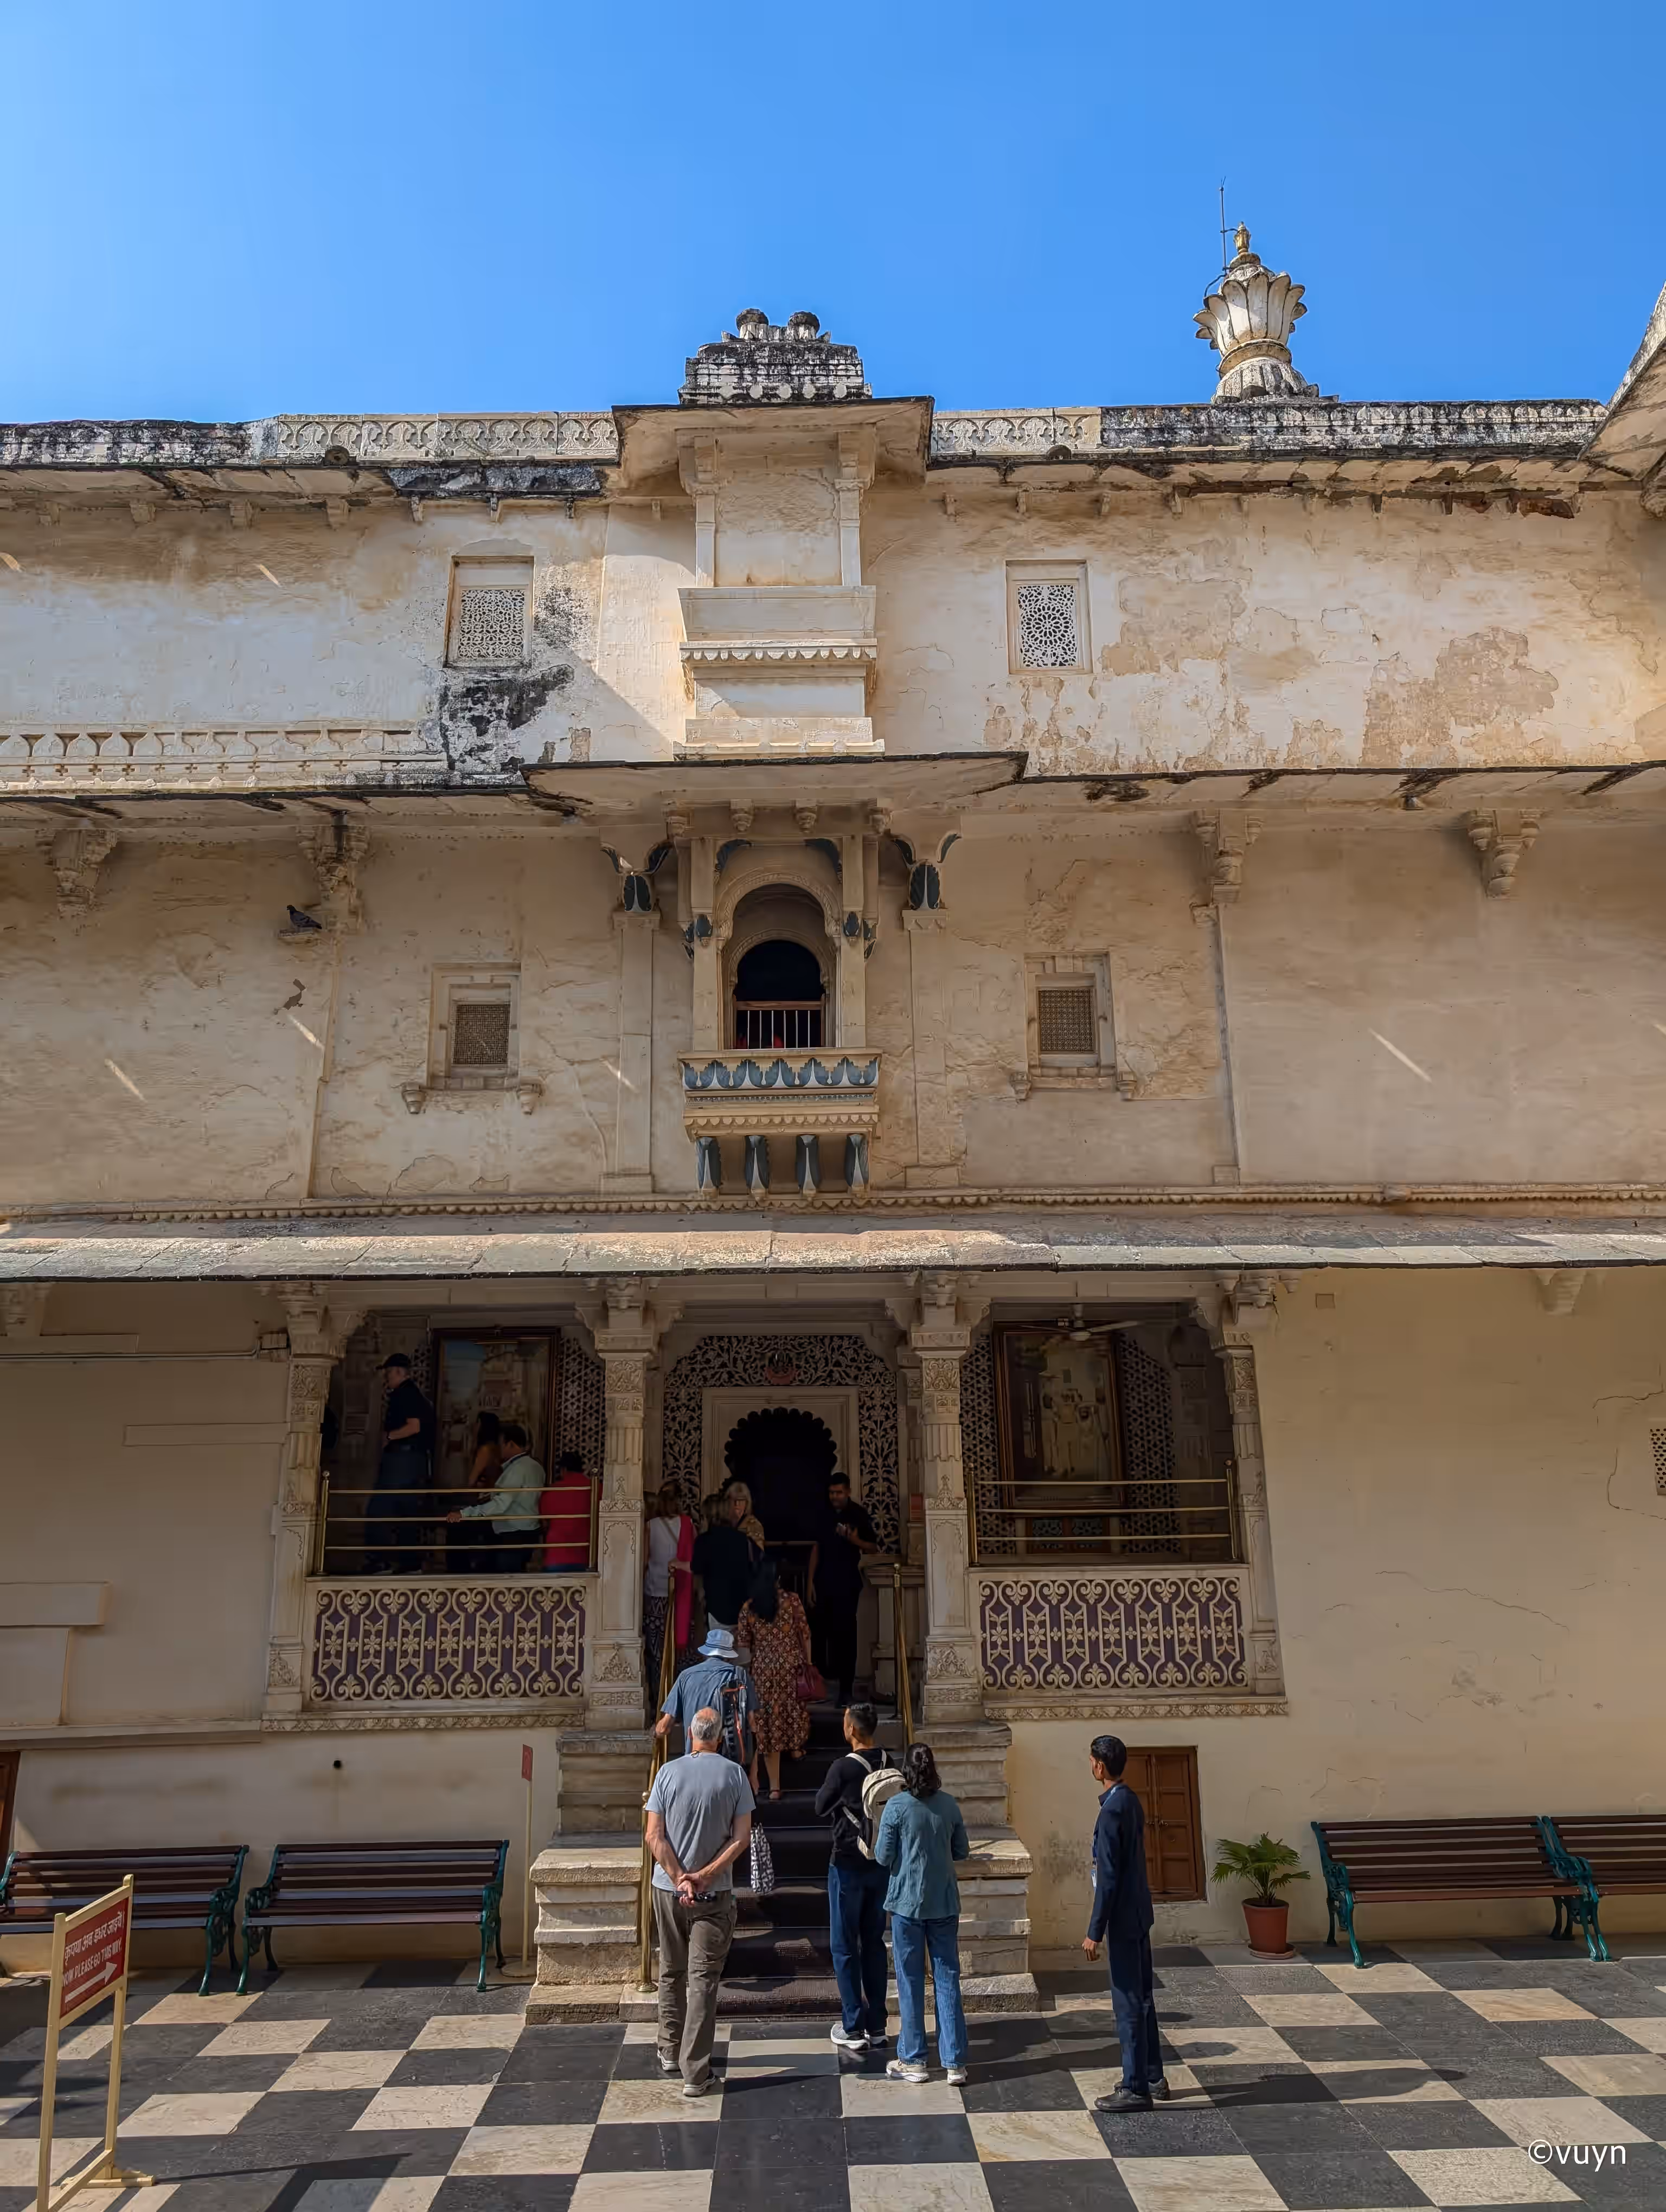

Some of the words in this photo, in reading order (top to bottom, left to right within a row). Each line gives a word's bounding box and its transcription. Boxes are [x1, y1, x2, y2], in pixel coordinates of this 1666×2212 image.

[62, 1968, 74, 1986] NOW
[75, 1956, 93, 1978] PLEASE
[94, 1952, 100, 1966] GO
[101, 1944, 112, 1962] THIS
[65, 1938, 81, 1965] कृपया
[82, 1931, 94, 1951] अब
[94, 1924, 107, 1943] इधर
